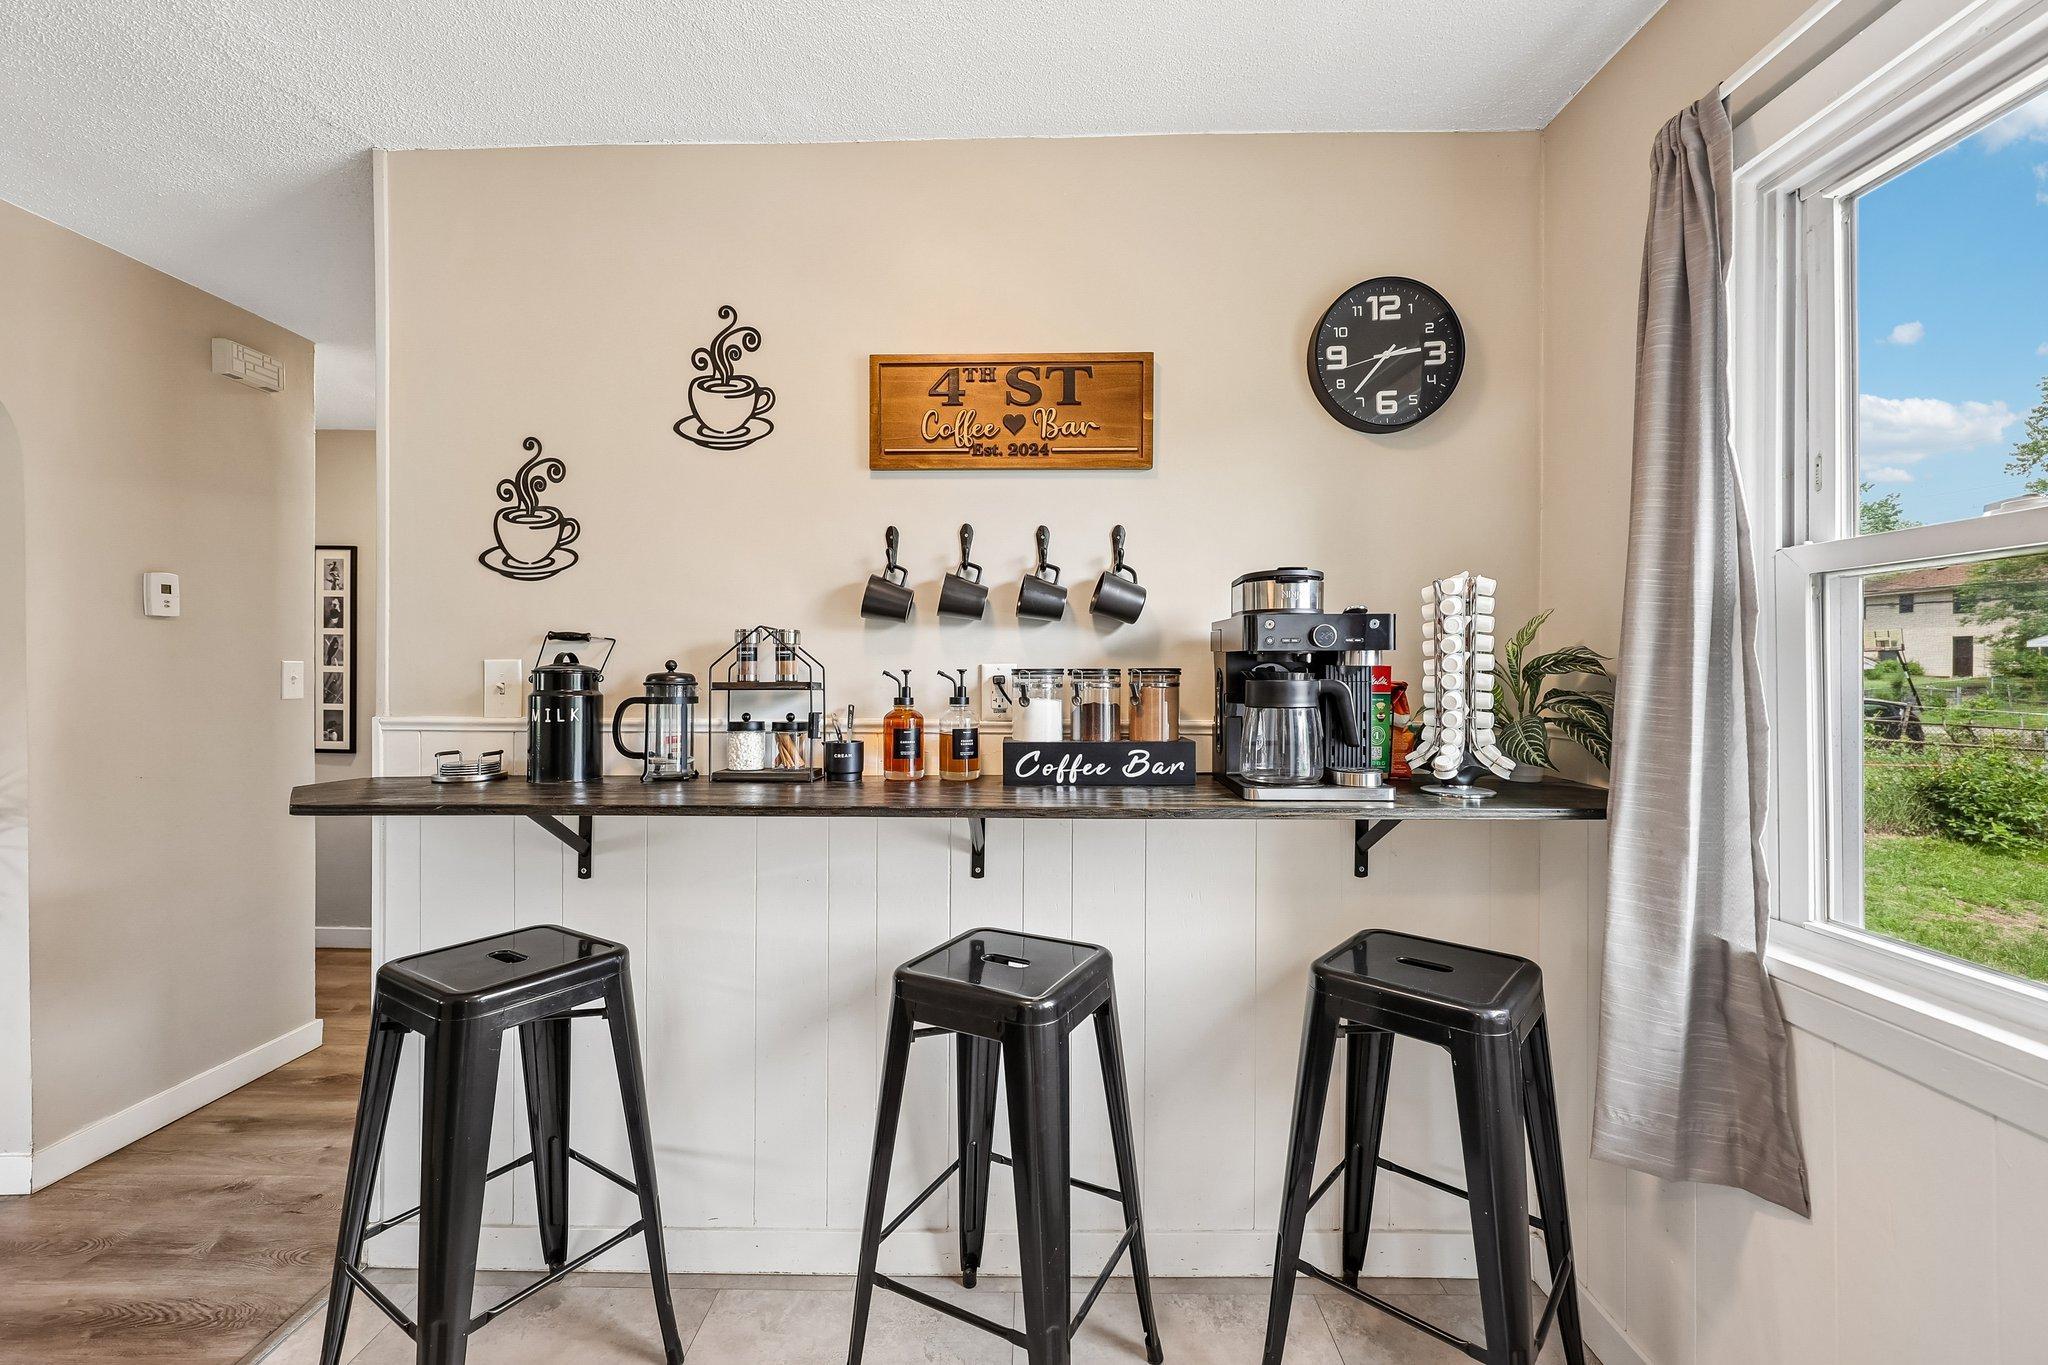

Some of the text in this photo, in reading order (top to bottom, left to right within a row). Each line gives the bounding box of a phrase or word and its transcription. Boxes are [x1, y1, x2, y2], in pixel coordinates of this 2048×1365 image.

[1352, 305, 1363, 316] 11
[1366, 295, 1402, 321] 12
[1408, 303, 1413, 314] 1
[1333, 326, 1348, 338] 10
[1425, 322, 1435, 333] 2
[1326, 345, 1348, 371] 9
[1424, 340, 1447, 366] 3
[928, 365, 1094, 407] 4TH ST
[1336, 378, 1346, 389] 8
[1426, 374, 1437, 385] 4
[1355, 397, 1365, 407] 7
[1375, 390, 1398, 415] 6
[1408, 394, 1418, 405] 5
[921, 407, 1101, 448] Coffee Bar
[971, 442, 1050, 457] Est. 2024
[1281, 589, 1304, 600] NINJ
[531, 707, 580, 722] MILK
[1015, 749, 1186, 784] Coffee Bar
